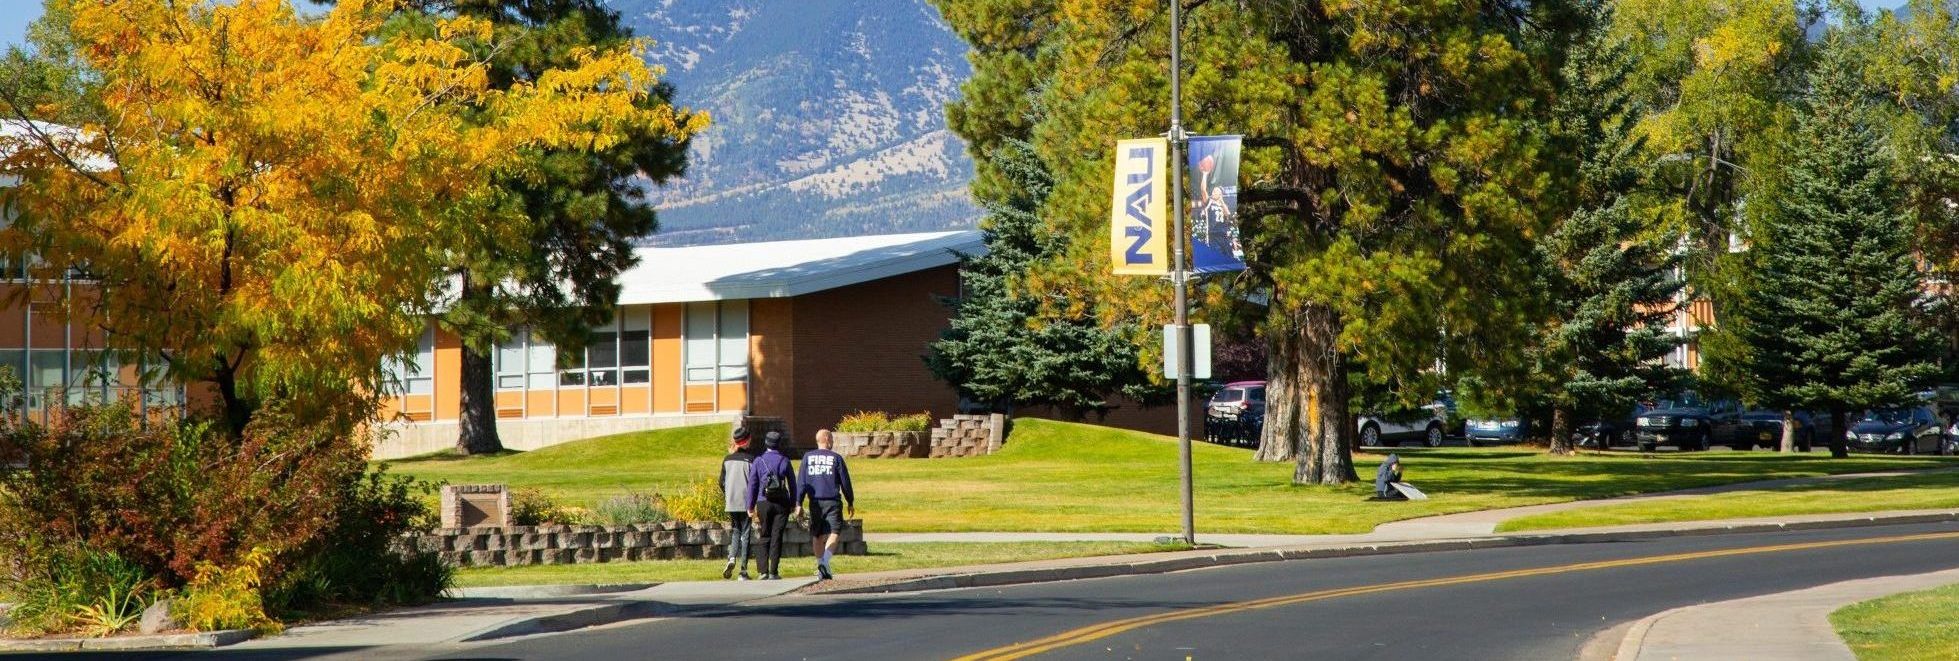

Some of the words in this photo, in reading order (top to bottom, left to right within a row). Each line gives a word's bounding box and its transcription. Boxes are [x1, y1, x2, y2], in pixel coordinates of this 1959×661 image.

[1125, 147, 1154, 265] NAU
[808, 455, 834, 465] FIRE
[808, 465, 833, 476] DEPT.
